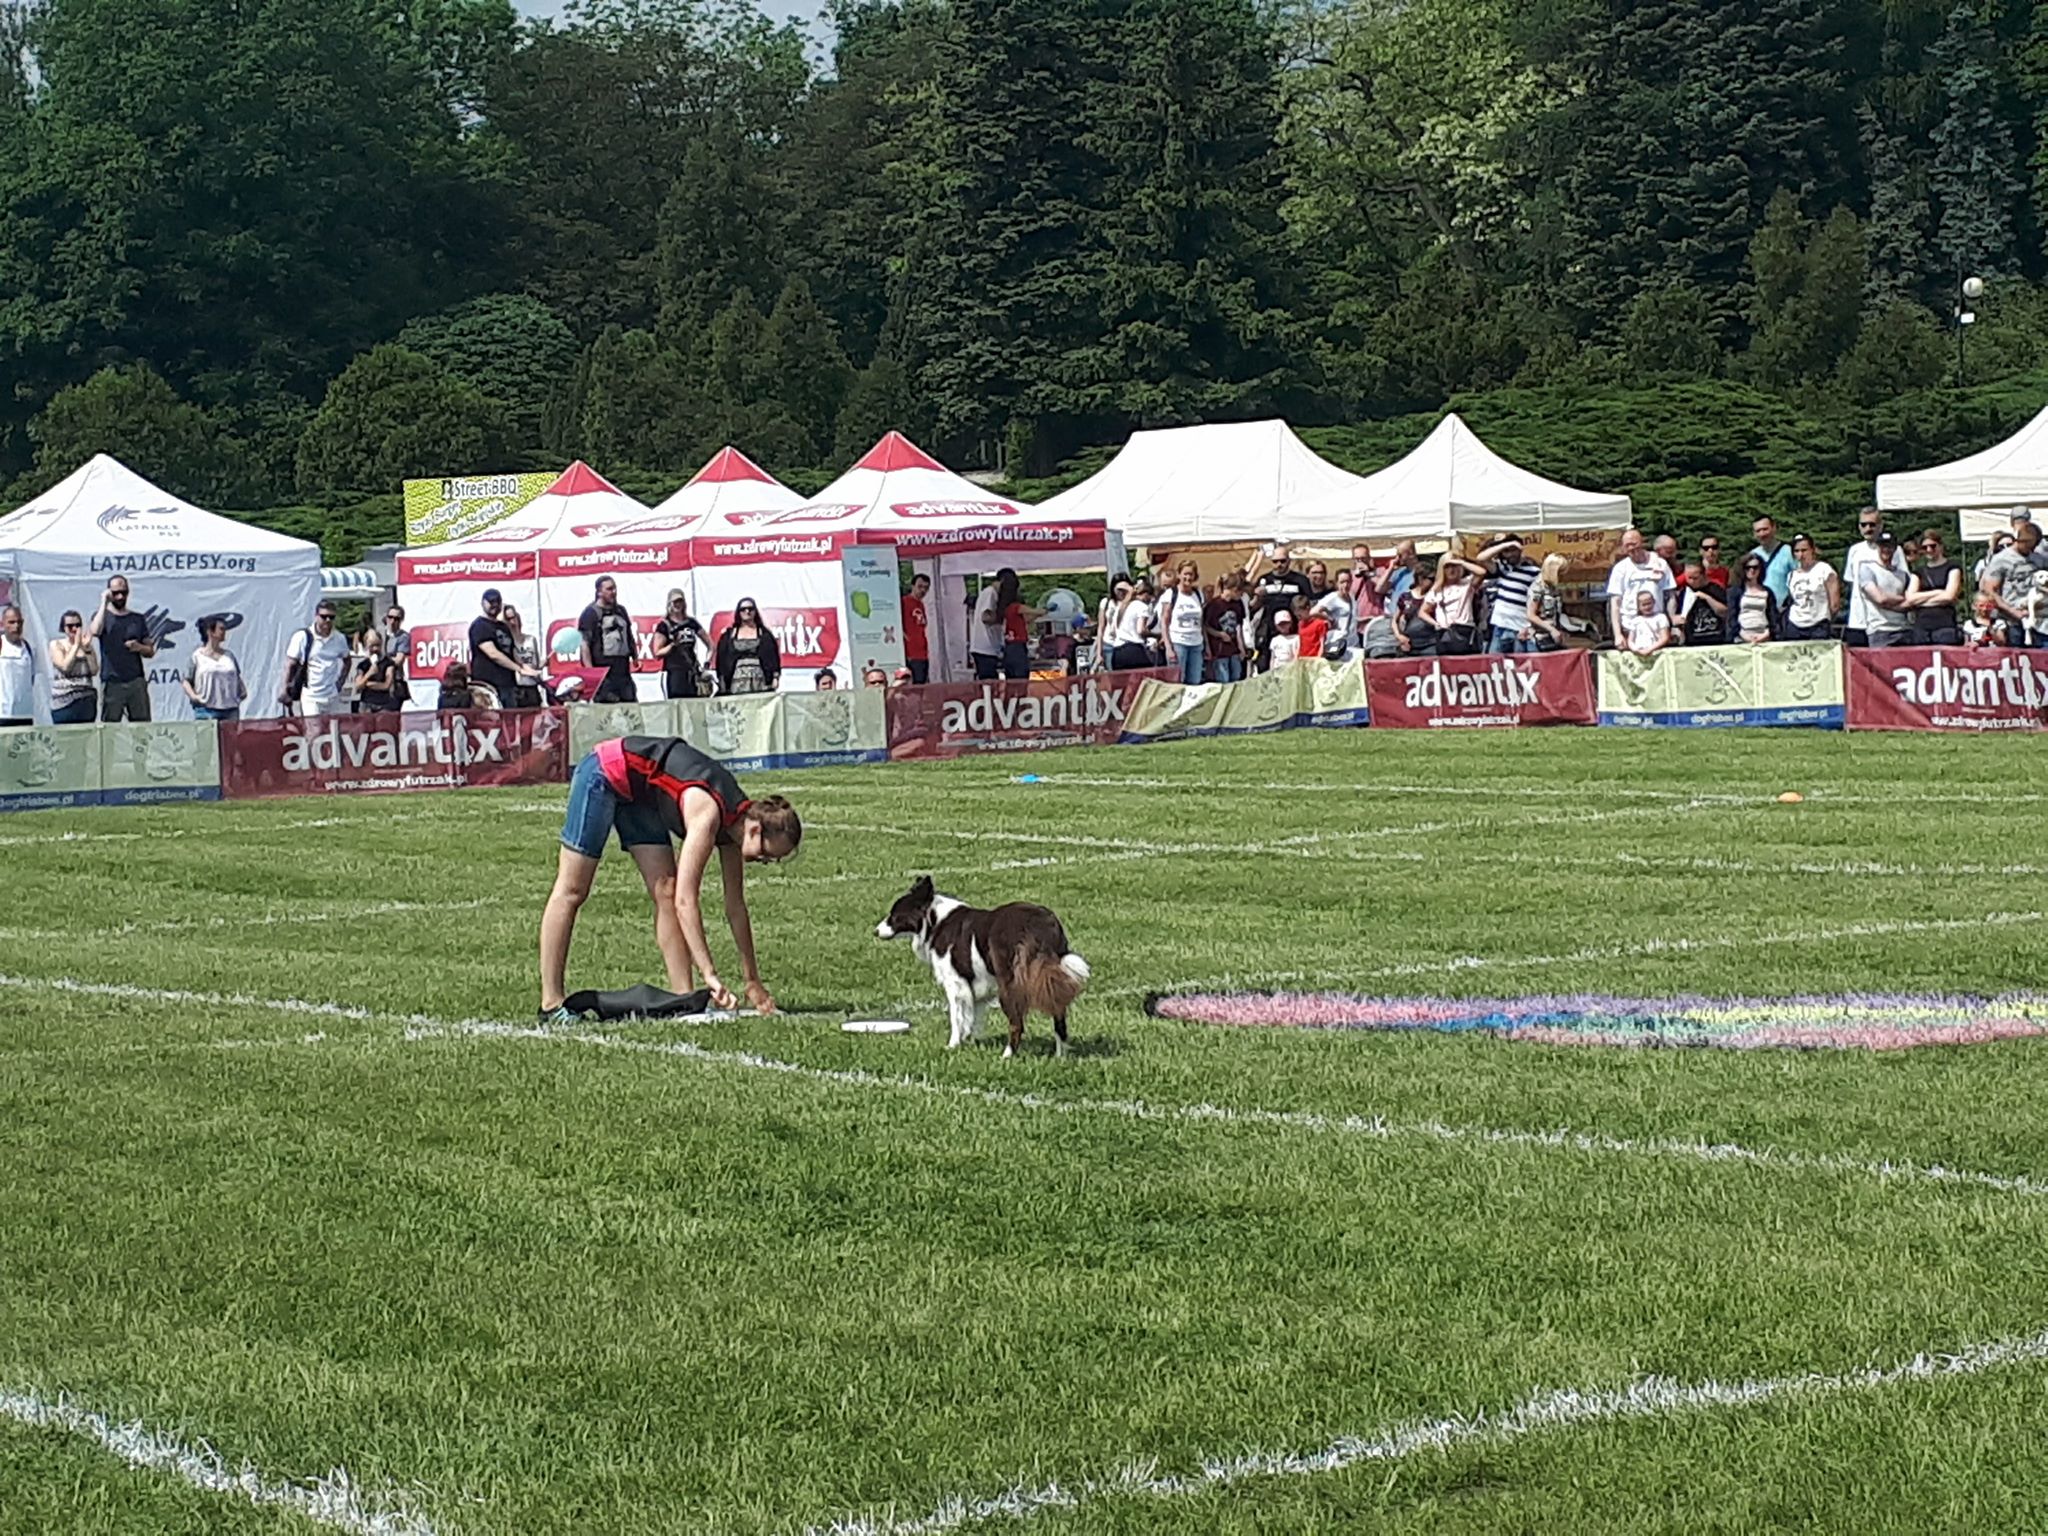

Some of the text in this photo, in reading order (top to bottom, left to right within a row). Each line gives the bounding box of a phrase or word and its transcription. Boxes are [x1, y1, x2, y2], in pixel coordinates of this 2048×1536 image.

[492, 478, 516, 494] BBQ
[896, 524, 1073, 547] www.zdrowyfutrzak.pl
[90, 553, 256, 572] LATAJACEPSY.org
[1405, 659, 1540, 708] advantix
[941, 679, 1124, 734] advantix
[282, 714, 503, 771] advantix
